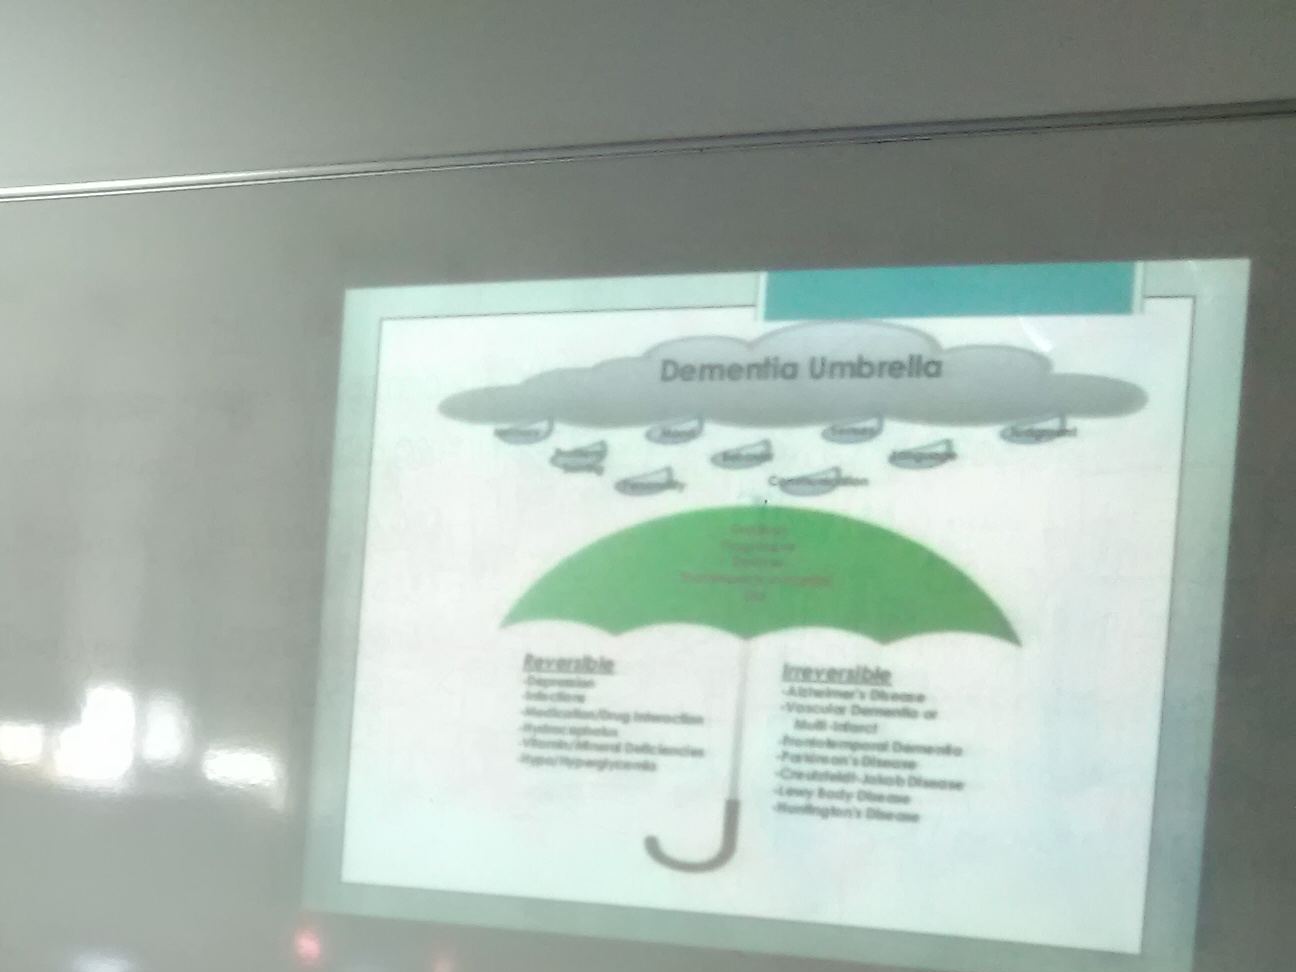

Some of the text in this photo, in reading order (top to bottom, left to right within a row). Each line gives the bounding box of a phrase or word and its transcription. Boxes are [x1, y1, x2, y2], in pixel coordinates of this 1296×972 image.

[660, 353, 942, 382] Dementia Umbrella
[522, 652, 614, 675] Reversible
[782, 661, 892, 687] Irreversible
